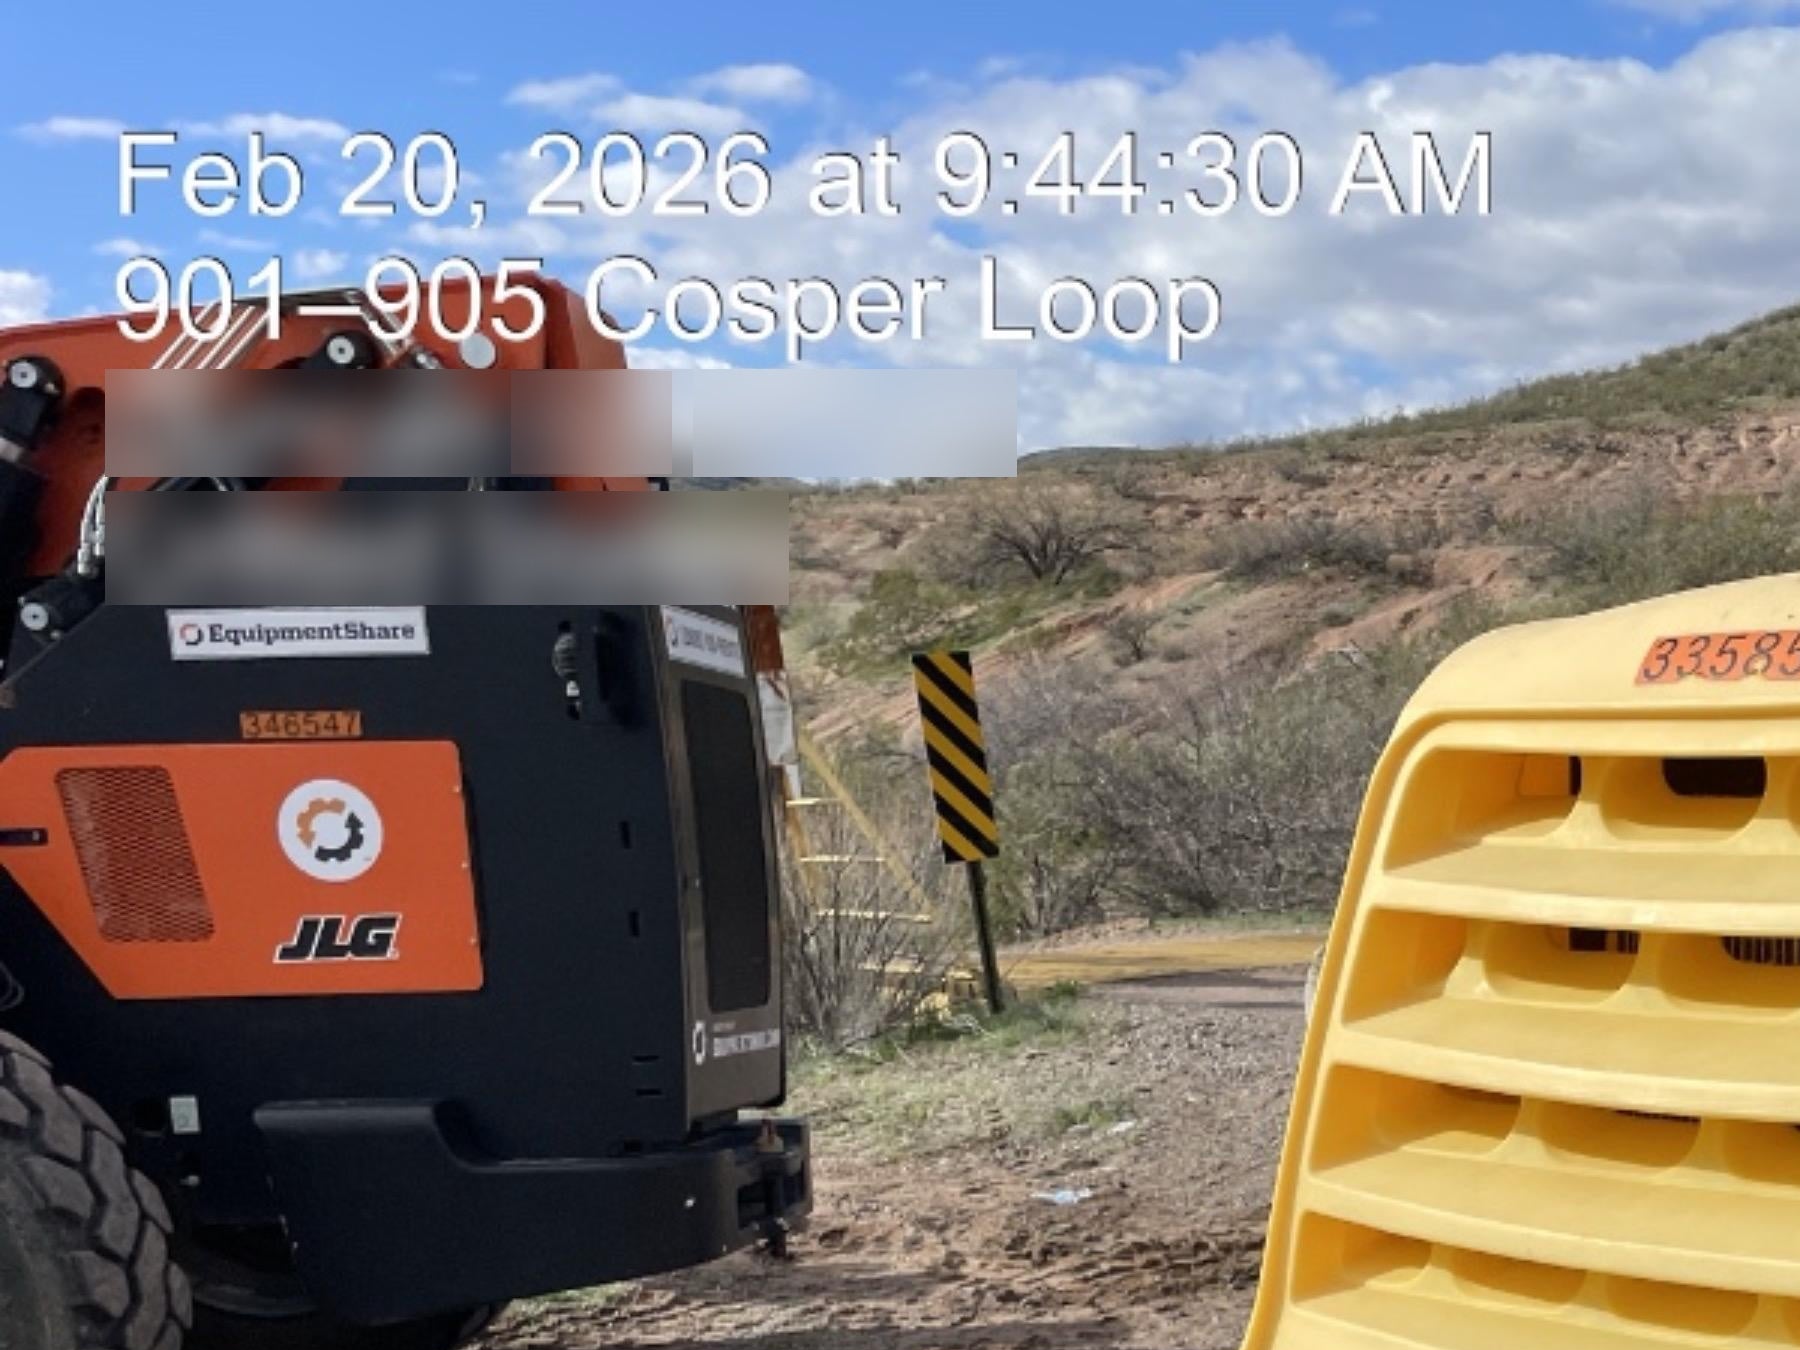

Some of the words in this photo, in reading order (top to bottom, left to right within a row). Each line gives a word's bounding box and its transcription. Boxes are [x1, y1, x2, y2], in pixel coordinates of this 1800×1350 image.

[208, 622, 415, 646] EquipmentShare
[244, 712, 360, 736] 346547
[274, 913, 402, 963] JLG
